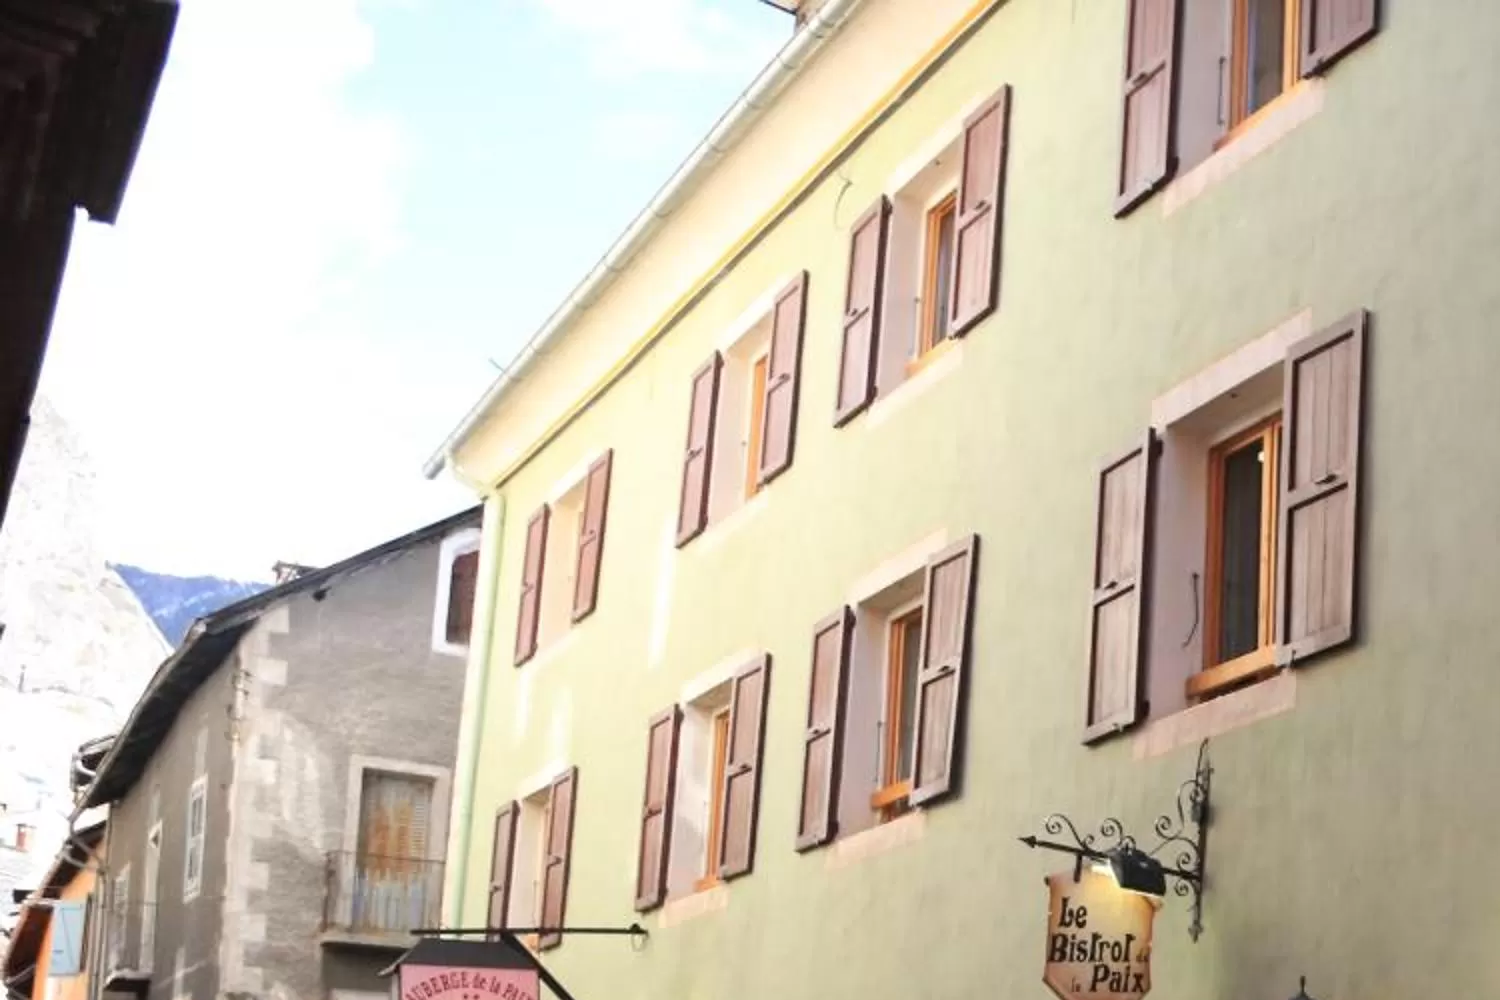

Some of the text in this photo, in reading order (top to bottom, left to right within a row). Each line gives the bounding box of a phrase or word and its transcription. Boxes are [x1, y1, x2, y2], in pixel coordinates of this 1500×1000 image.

[1058, 896, 1087, 928] Le
[1049, 932, 1136, 962] Bistrot
[472, 972, 487, 989] de
[1089, 963, 1145, 993] Paix
